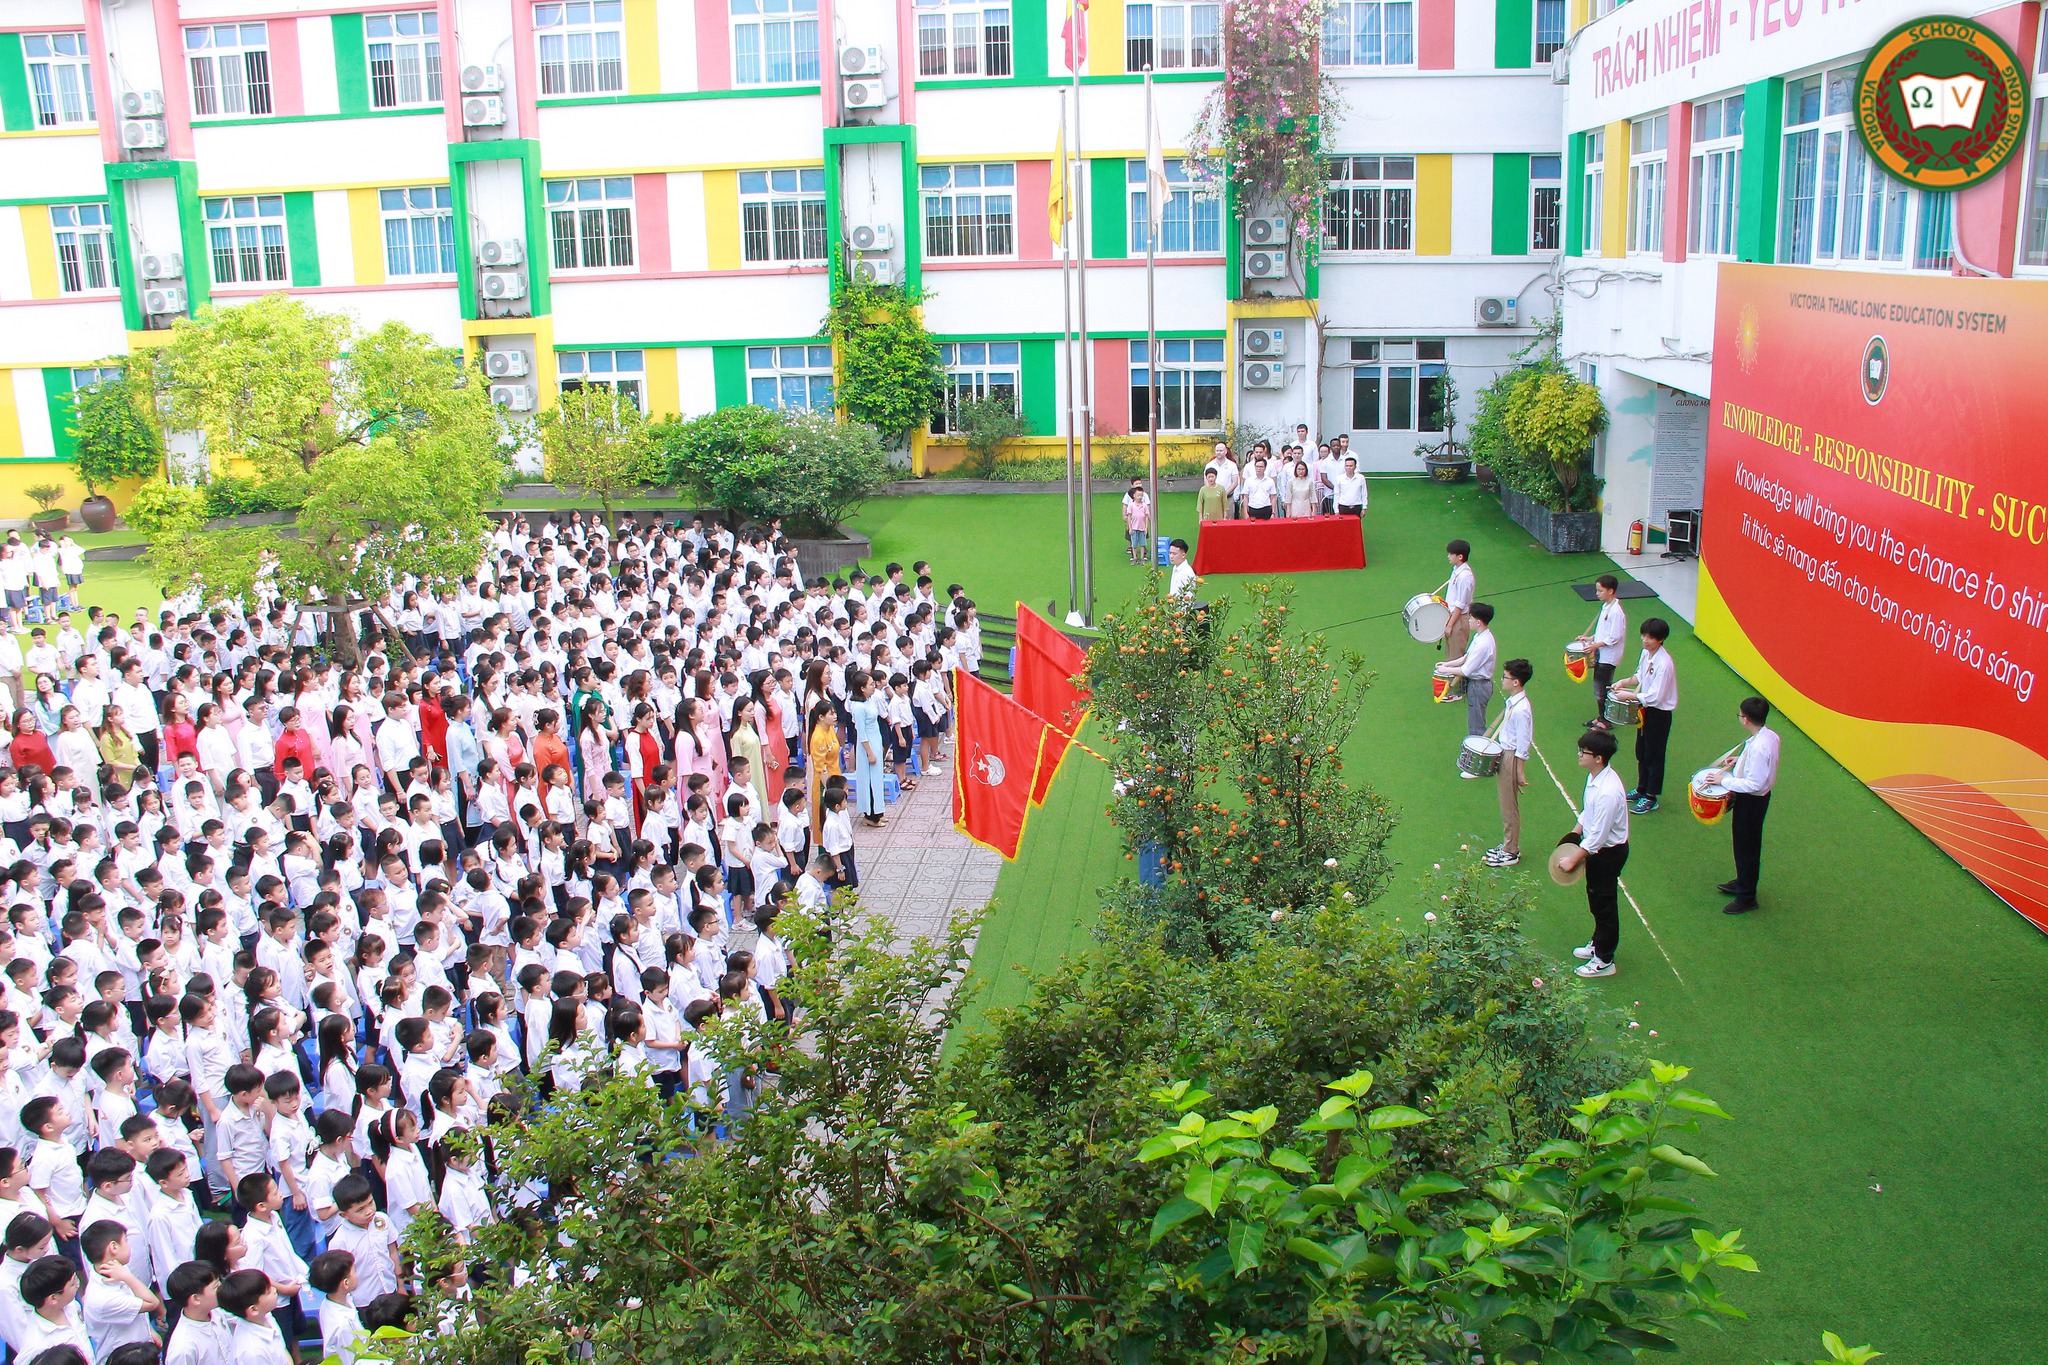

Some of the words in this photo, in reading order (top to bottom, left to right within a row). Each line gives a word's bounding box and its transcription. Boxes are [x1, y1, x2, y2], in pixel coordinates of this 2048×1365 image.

[1592, 25, 1648, 99] TRÁCH
[1789, 292, 1826, 312] VICTORIA
[1828, 297, 1858, 316] THANG
[1860, 301, 1887, 320] LONG
[1889, 304, 1953, 328] EDUCATION
[1956, 311, 2007, 335] SYSTEM
[1722, 401, 1803, 456] KNOWLEDGE
[1812, 432, 1975, 520] RESPONSIBILITY
[1989, 492, 2048, 545] SUC
[1734, 460, 1792, 513] Knowledge
[1794, 492, 1814, 521] will
[1813, 497, 1848, 544] bring
[1847, 520, 1877, 553] you
[1878, 527, 1905, 565] the
[1907, 544, 1979, 599] chance
[1983, 571, 2006, 611] to
[1751, 518, 1773, 550] thức
[1772, 533, 1785, 557] sẽ
[1785, 543, 1818, 582] mang
[1818, 559, 1842, 592] đến
[1843, 574, 1869, 606] cho
[1870, 585, 1899, 624] bạn
[1901, 608, 1924, 635] cơ
[1923, 613, 1952, 655] hội
[1952, 628, 1984, 670] tỏa
[1985, 650, 2035, 703] sáng
